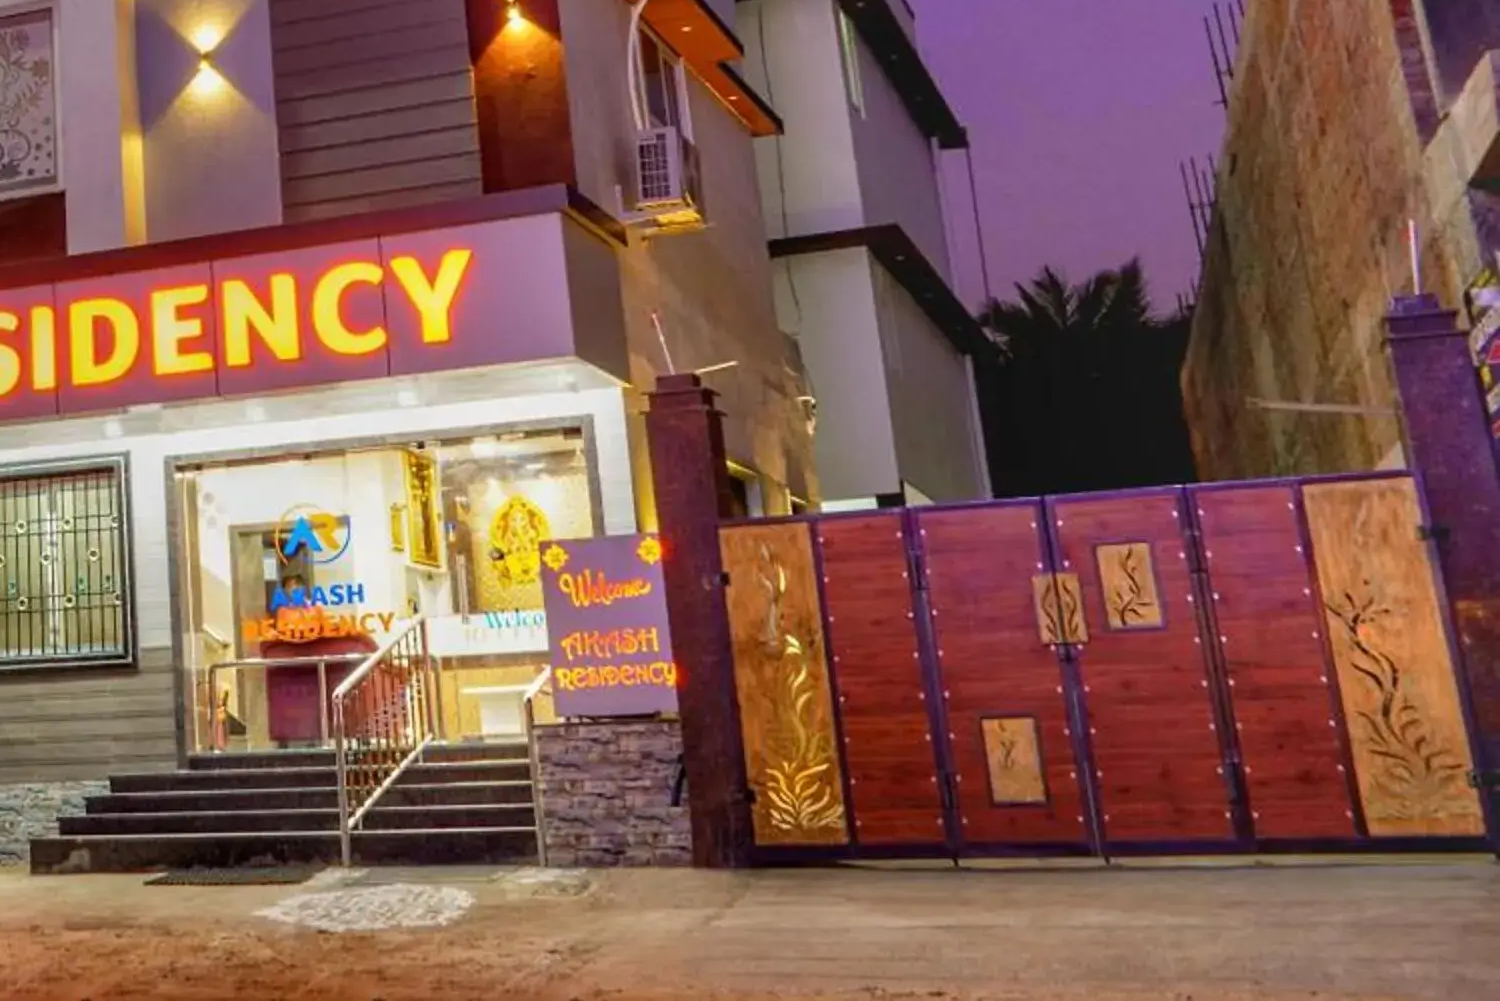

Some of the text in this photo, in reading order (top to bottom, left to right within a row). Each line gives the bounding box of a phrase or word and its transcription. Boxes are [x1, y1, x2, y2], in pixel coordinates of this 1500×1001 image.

[558, 568, 652, 608] Welcome
[485, 607, 544, 630] Welco
[560, 626, 660, 661] AKASH
